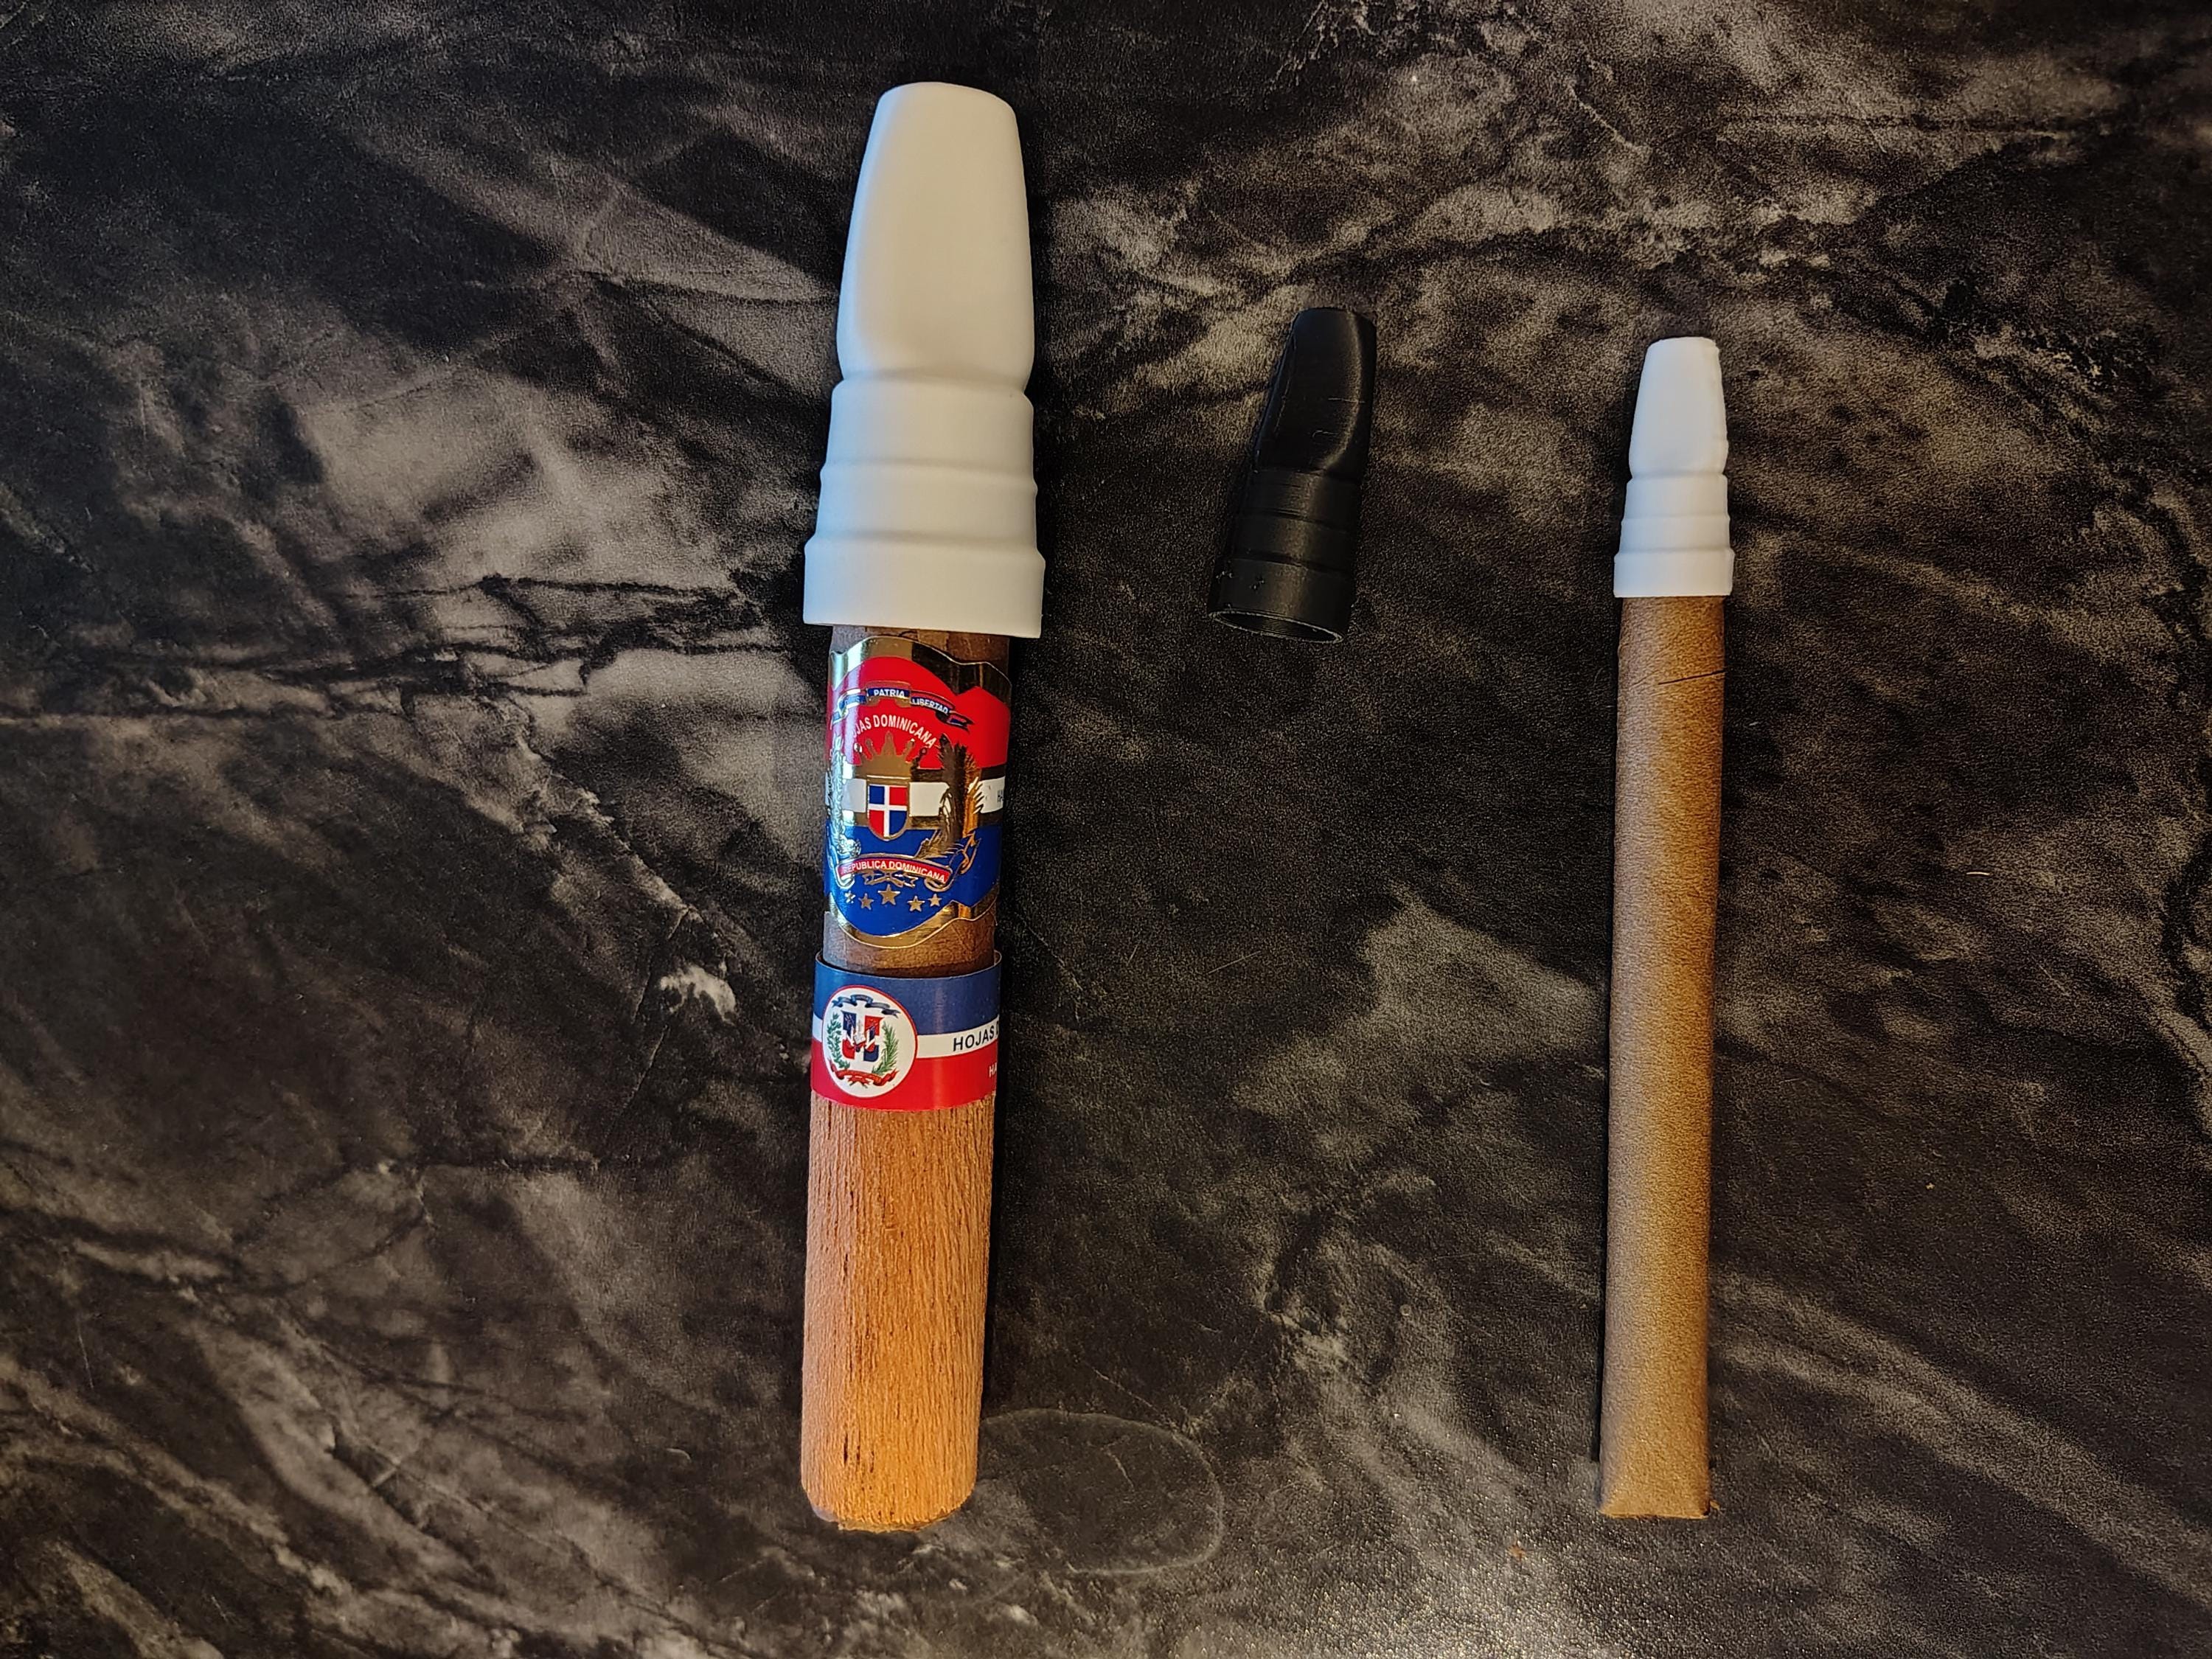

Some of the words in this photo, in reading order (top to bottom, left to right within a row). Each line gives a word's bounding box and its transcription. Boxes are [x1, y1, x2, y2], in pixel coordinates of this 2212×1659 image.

[873, 689, 905, 698] PATRIA
[912, 697, 948, 714] LIBERTAD
[873, 714, 937, 749] DOMINICANA
[888, 861, 945, 883] DOMINICANA
[953, 1025, 995, 1052] HOJAS
